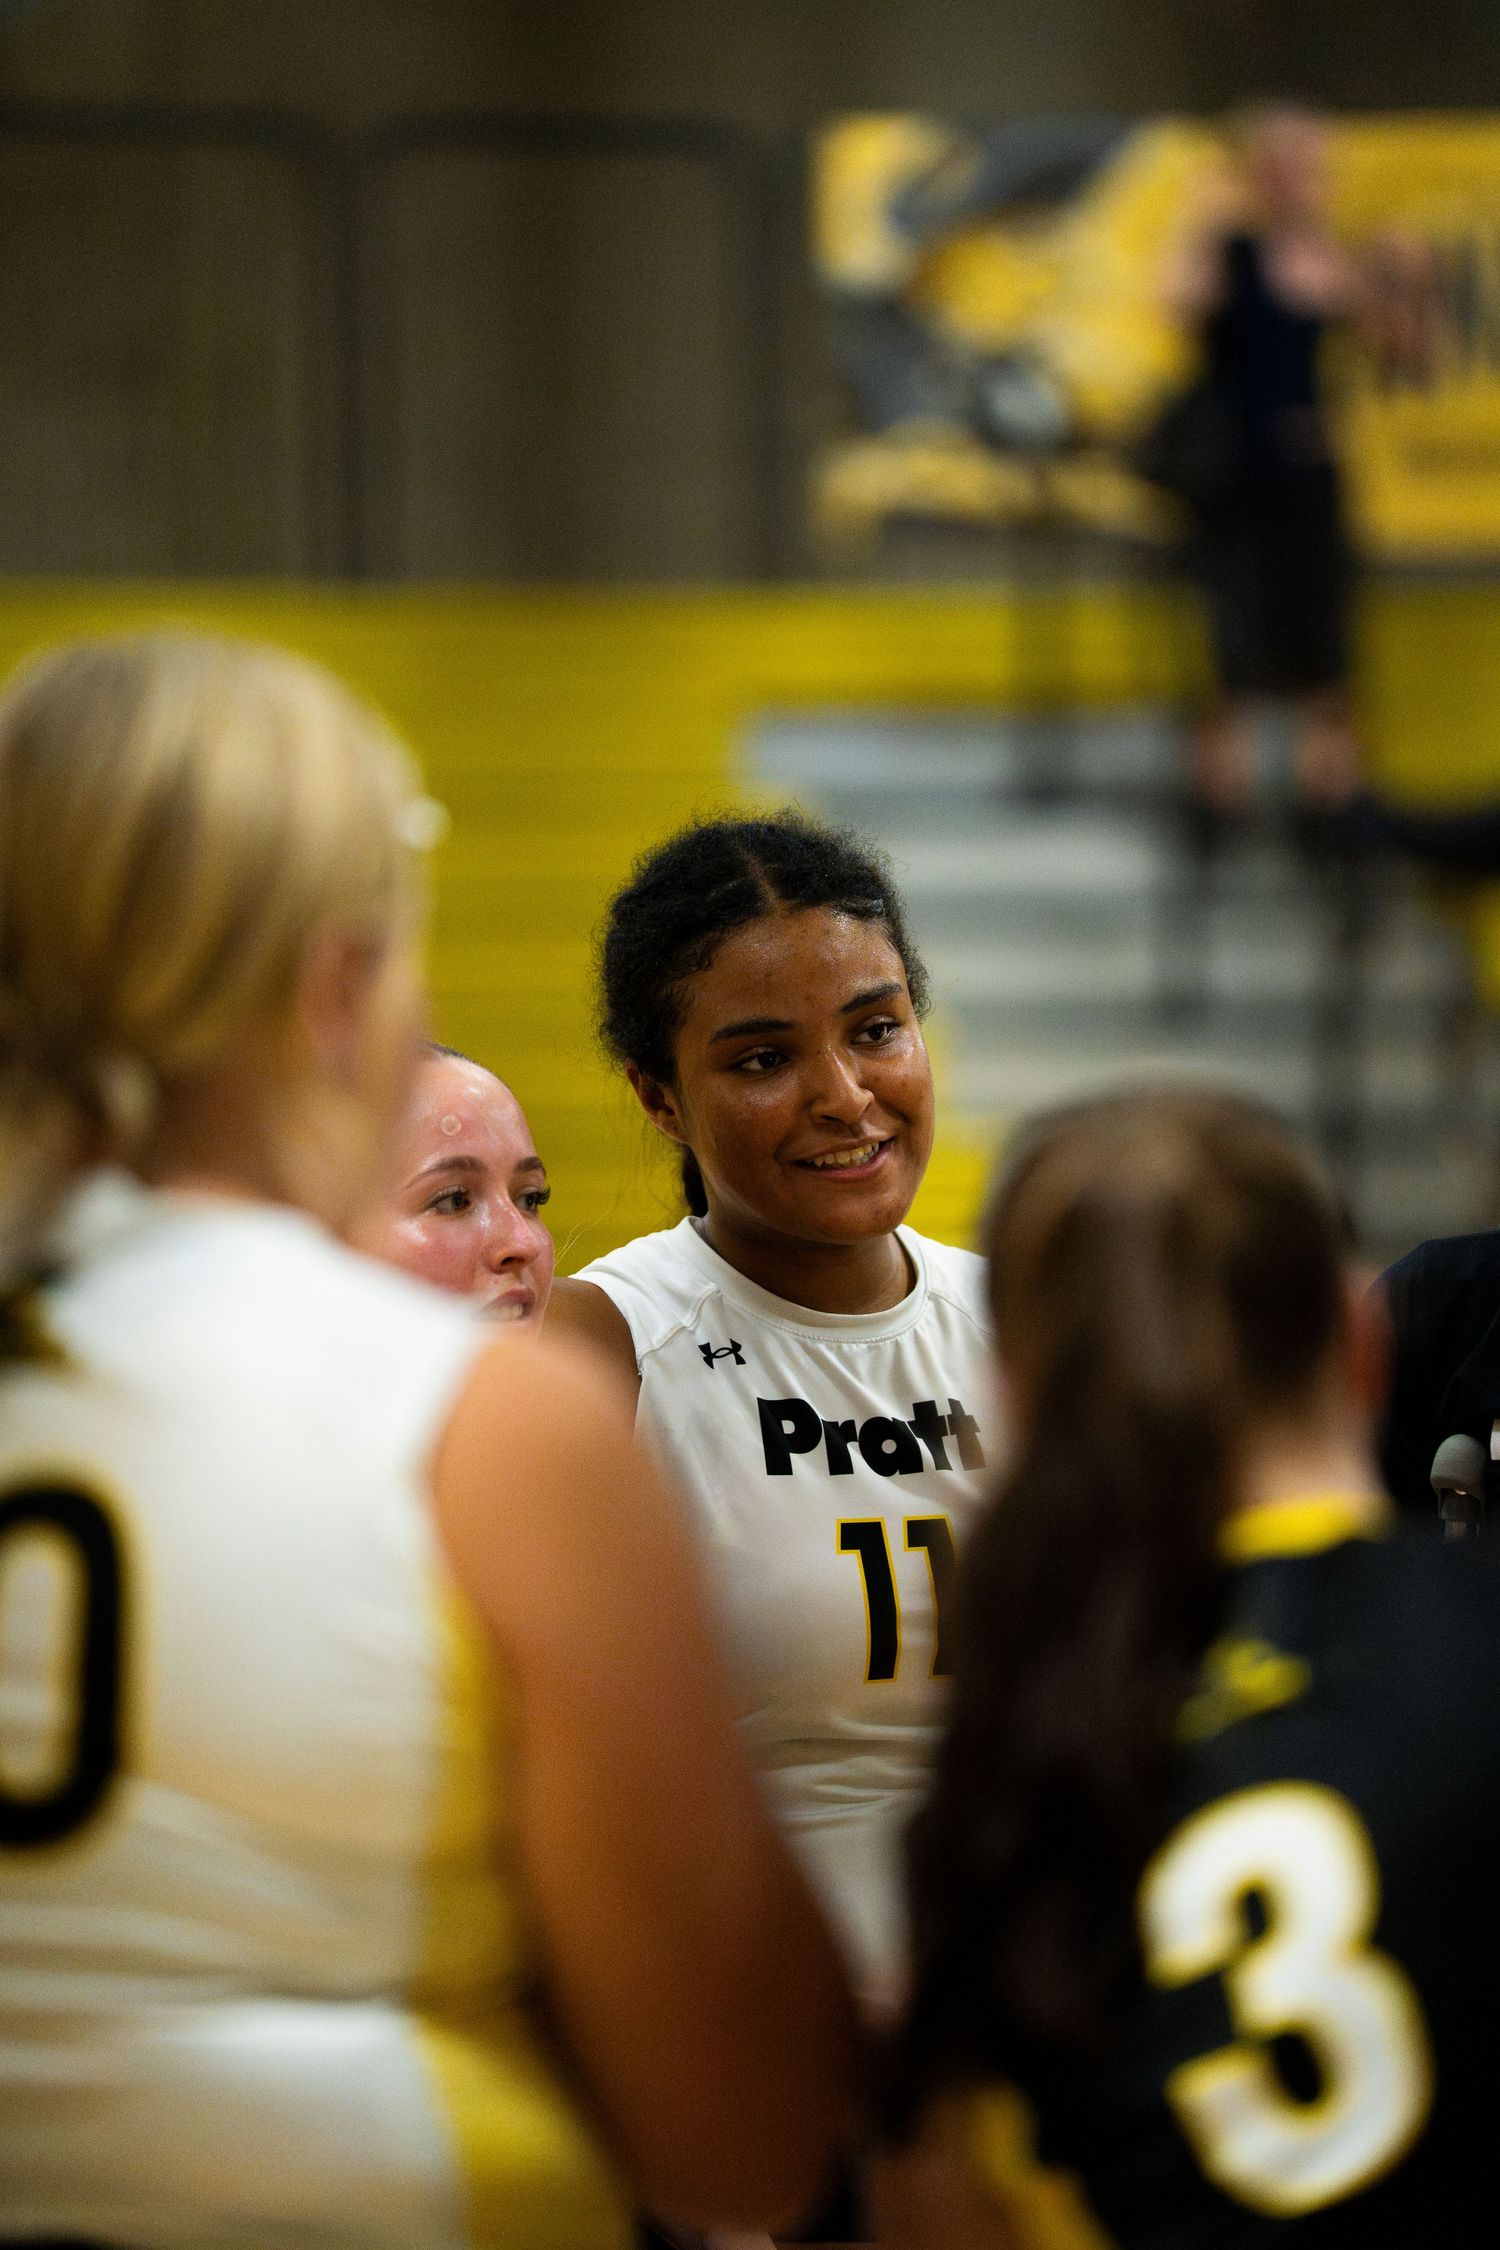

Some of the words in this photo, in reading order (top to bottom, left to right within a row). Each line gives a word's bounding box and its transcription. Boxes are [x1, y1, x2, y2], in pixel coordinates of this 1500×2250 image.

[756, 1397, 986, 1477] Pratt
[836, 1514, 960, 1684] 11
[1136, 1779, 1435, 2219] 3
